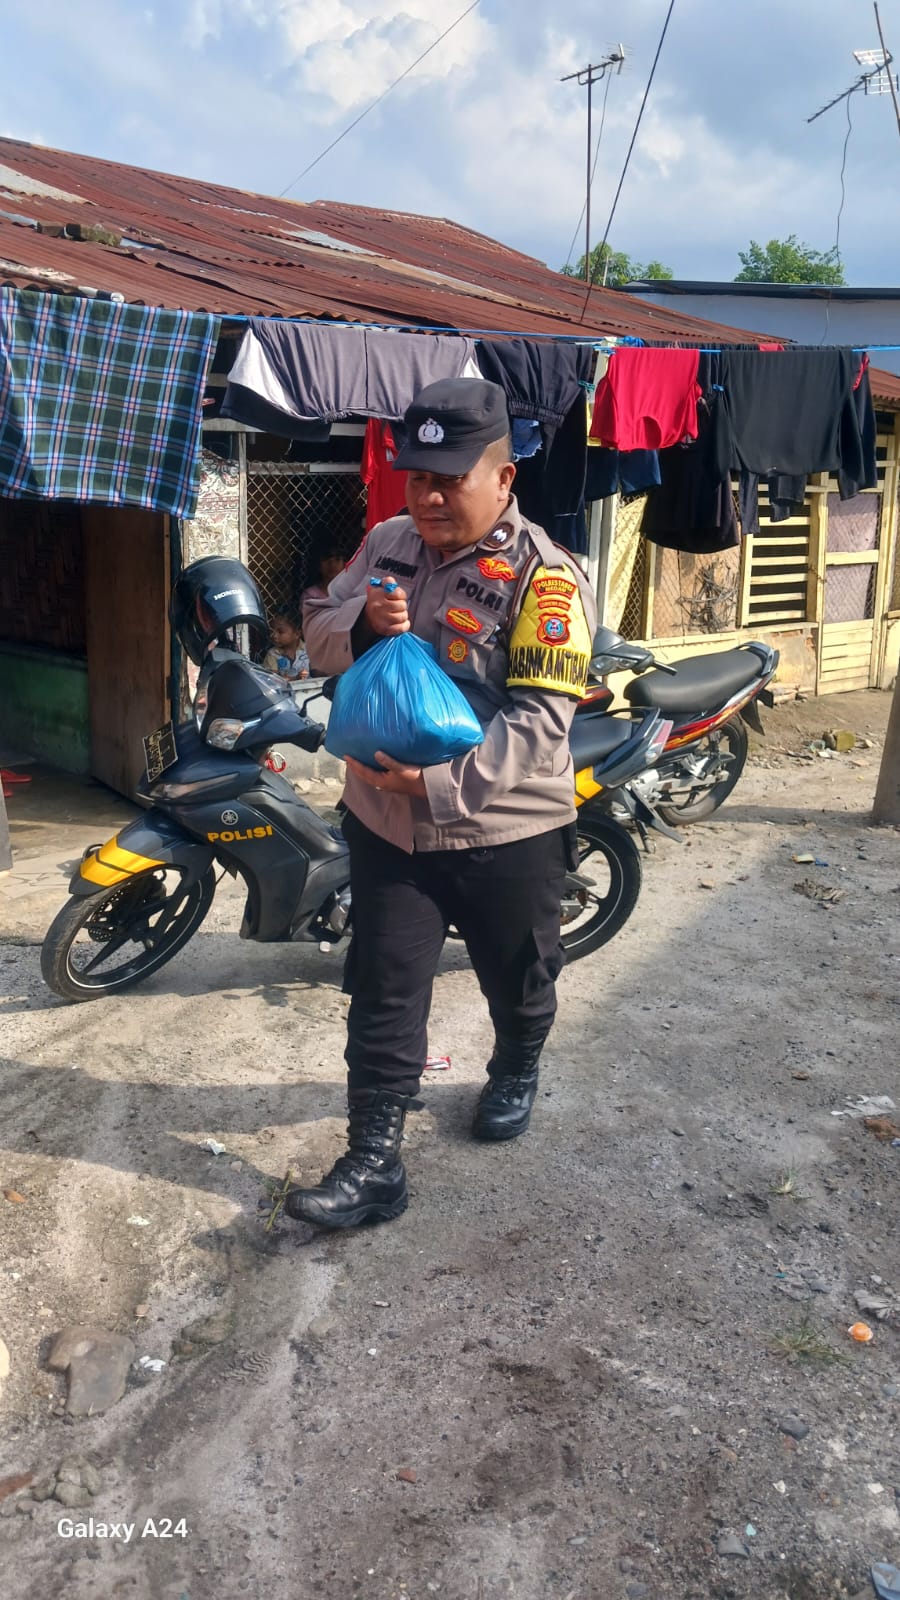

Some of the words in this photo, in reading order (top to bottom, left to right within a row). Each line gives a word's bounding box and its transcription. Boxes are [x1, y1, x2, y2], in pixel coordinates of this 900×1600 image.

[213, 589, 244, 601] HONDA
[455, 577, 503, 611] POLRI
[207, 824, 273, 842] POLISI
